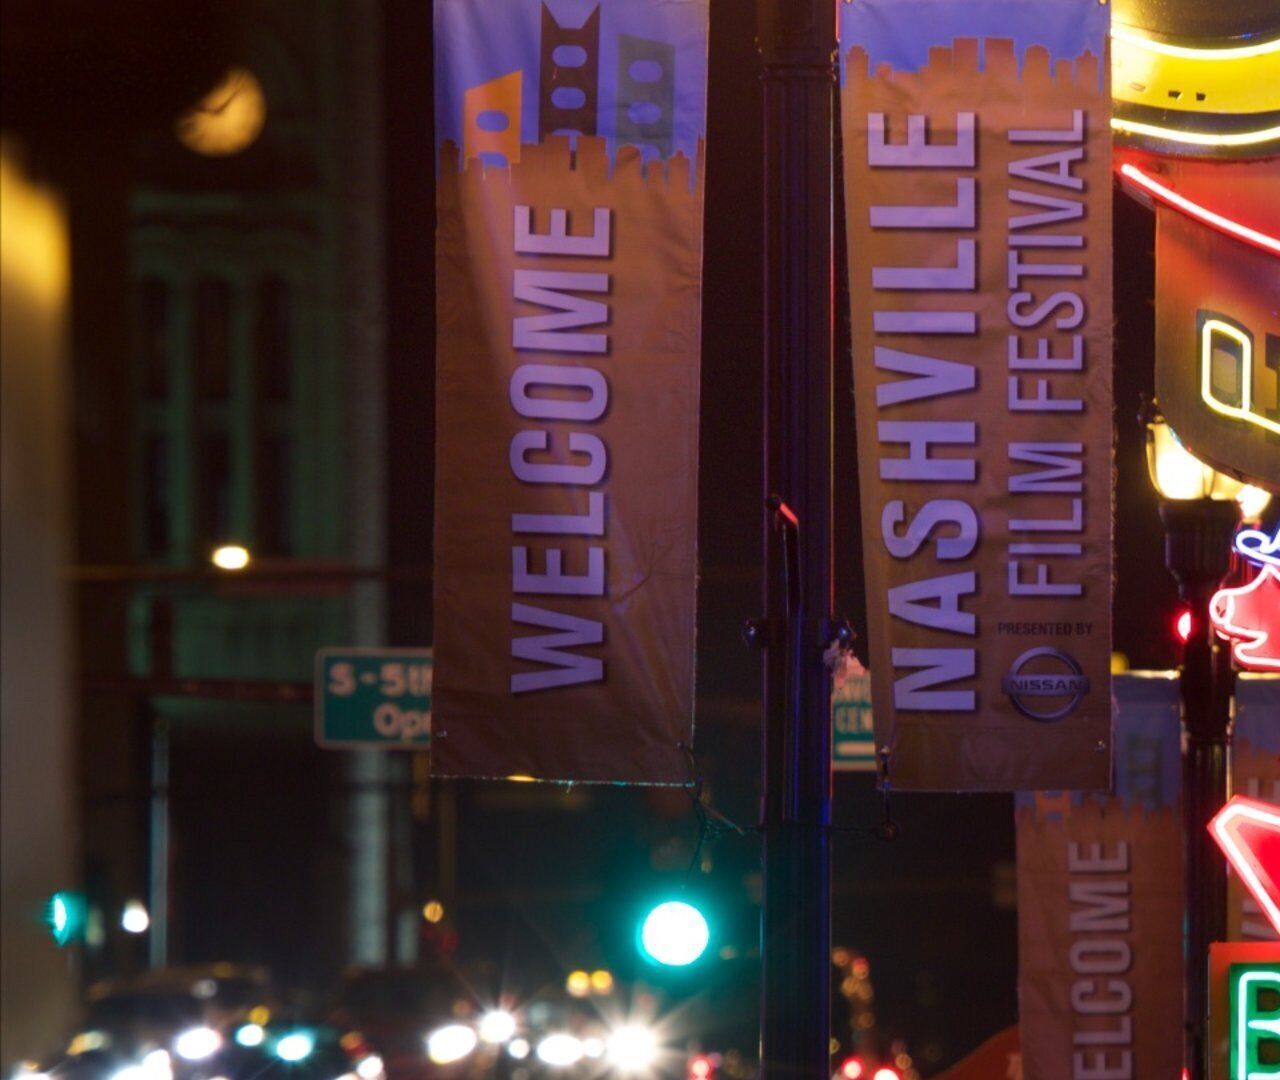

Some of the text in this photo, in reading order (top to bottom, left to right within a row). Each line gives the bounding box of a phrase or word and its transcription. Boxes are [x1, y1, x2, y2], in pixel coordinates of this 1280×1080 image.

[509, 205, 614, 695] WELCOME
[867, 110, 977, 712] NASHVILLE
[1008, 108, 1086, 598] FILM FESTIVAL
[998, 622, 1093, 635] PRESENTED BY
[1009, 679, 1084, 691] NISSAN
